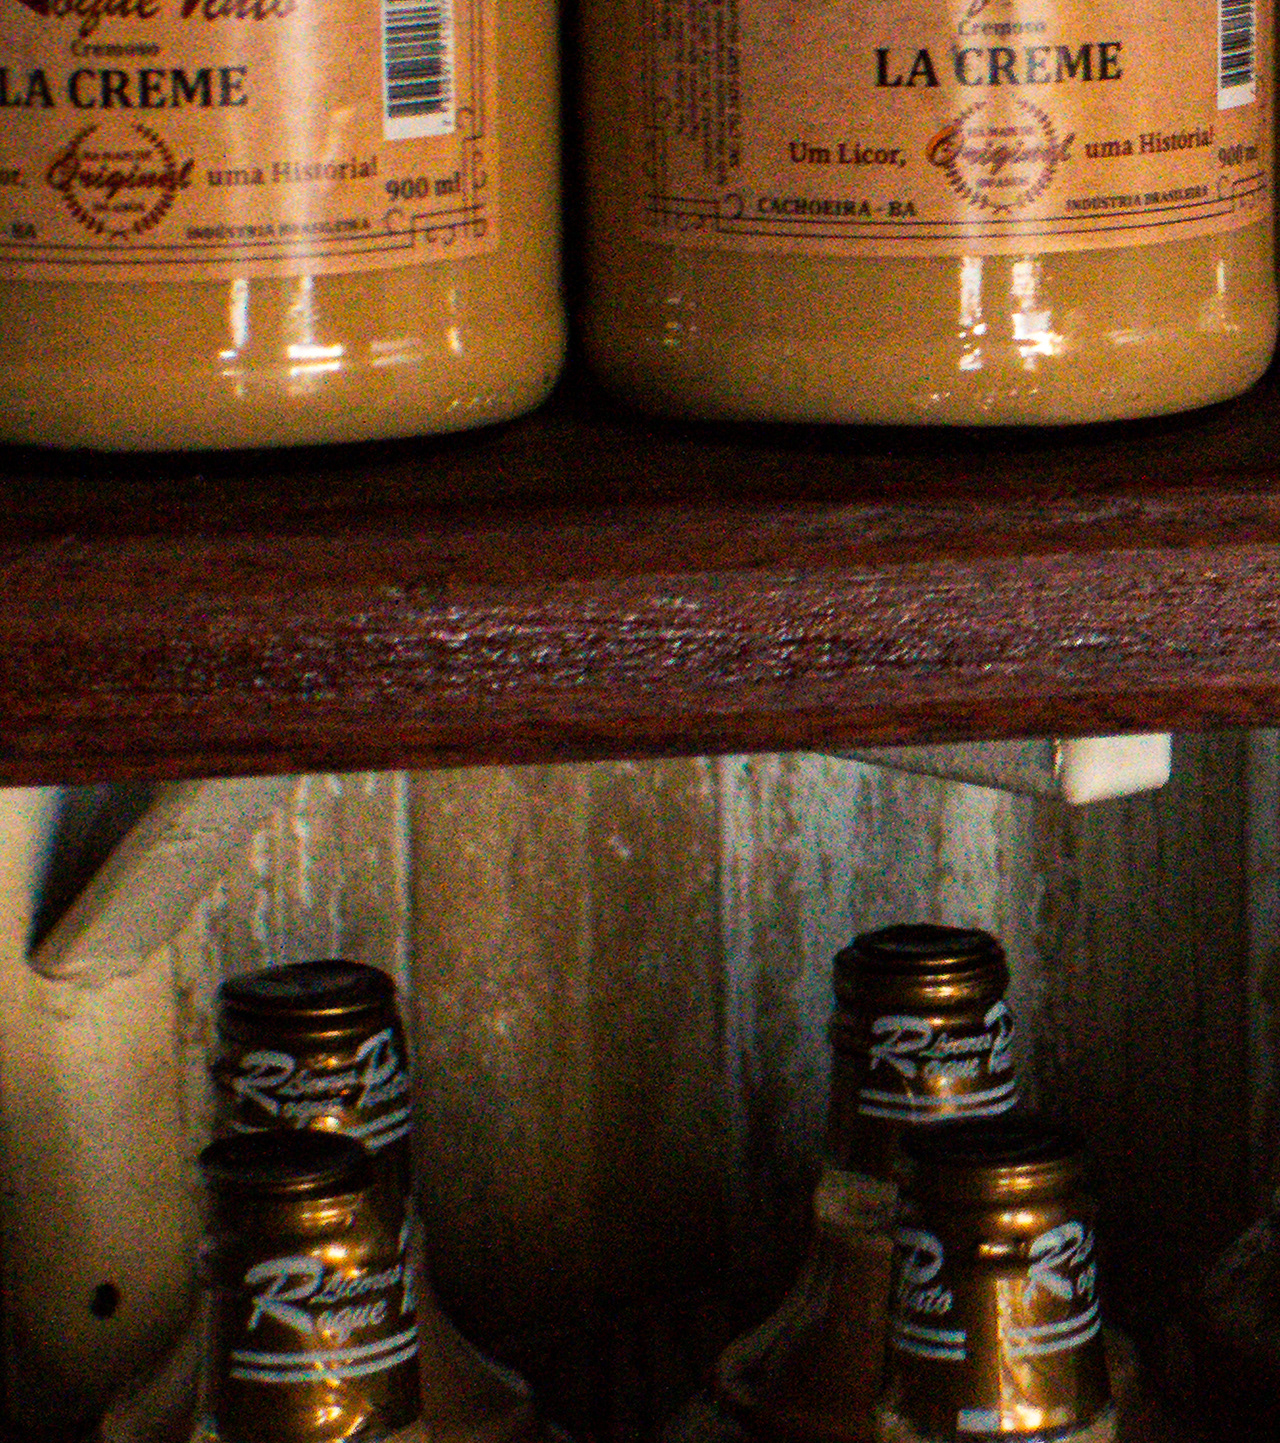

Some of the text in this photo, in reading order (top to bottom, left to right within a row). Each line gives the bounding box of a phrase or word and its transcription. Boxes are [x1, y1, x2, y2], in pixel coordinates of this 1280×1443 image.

[873, 42, 1124, 88] LA CREME
[66, 66, 249, 110] CREME
[788, 141, 906, 167] Um Licor,
[925, 129, 1077, 175] Original
[1084, 126, 1215, 159] uma História!
[46, 152, 195, 201] Original
[207, 167, 265, 187] uma
[384, 177, 431, 201] 900
[756, 198, 916, 218] CACHOEIRA BA
[244, 1253, 387, 1348] Roque
